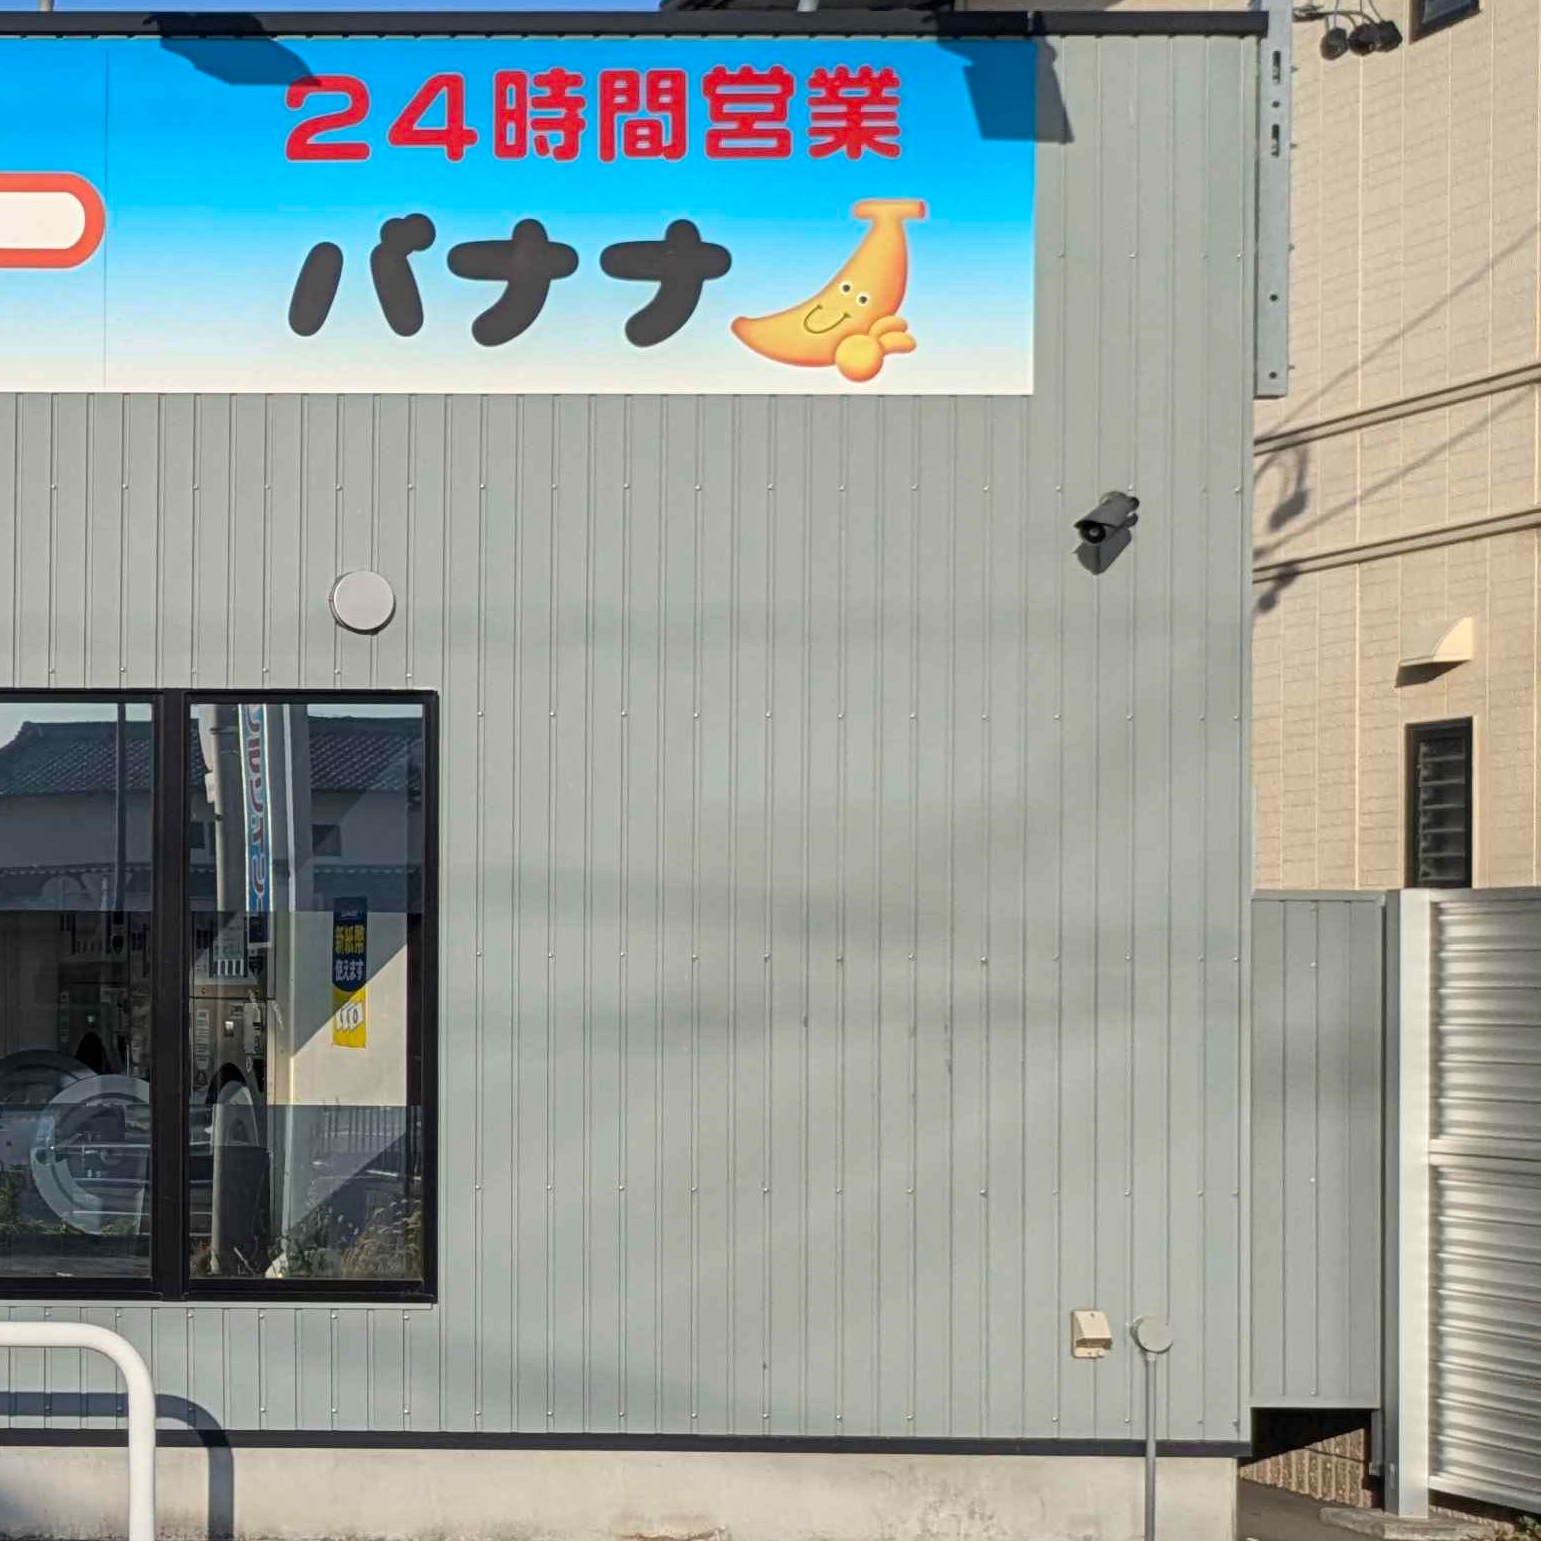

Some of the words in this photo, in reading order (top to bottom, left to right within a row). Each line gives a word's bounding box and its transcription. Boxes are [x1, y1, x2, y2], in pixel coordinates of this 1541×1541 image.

[283, 64, 904, 164] 24時間営業
[286, 211, 733, 349] バナナ
